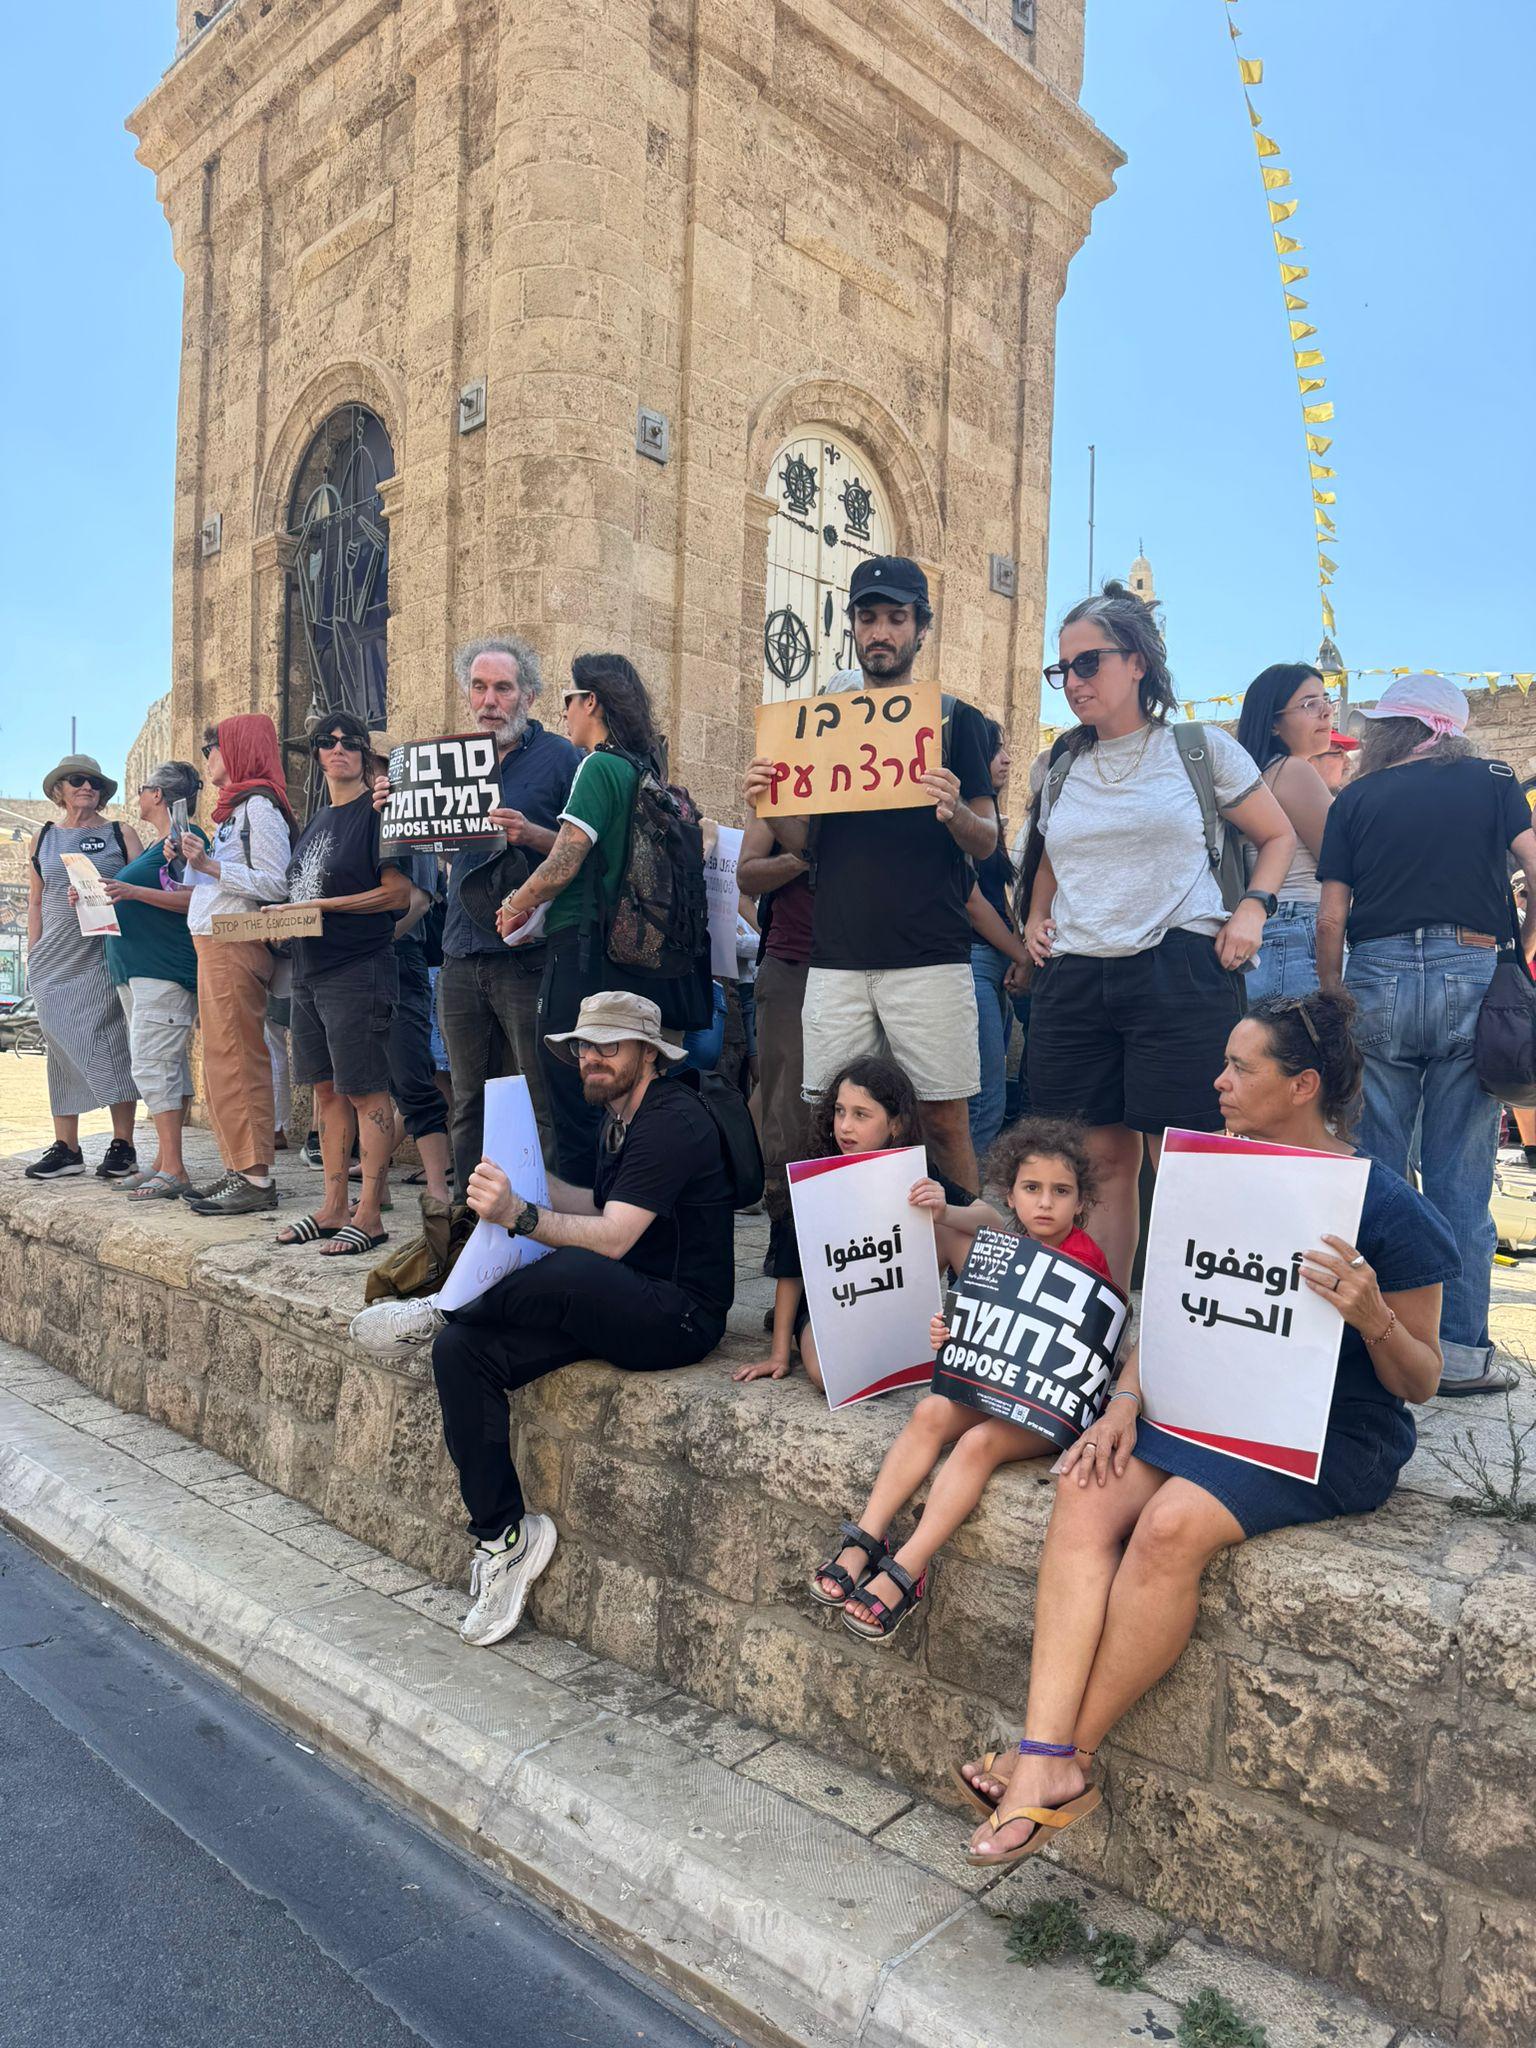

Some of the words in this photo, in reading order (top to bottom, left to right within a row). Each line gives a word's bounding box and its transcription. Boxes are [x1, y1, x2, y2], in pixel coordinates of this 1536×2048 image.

[796, 695, 911, 739] סרבו
[830, 727, 934, 792] לרצח
[383, 778, 500, 822] למלחמה
[771, 762, 815, 805] עם
[382, 821, 429, 839] OPPOSE
[431, 818, 463, 835] THE
[213, 921, 239, 935] STOP
[244, 918, 263, 930] THE
[266, 915, 302, 930] GENOCIDE
[303, 913, 318, 926] NOW
[825, 1224, 903, 1273] أوقفوا
[968, 1254, 1009, 1276] בעיניים
[973, 1242, 1016, 1260] לכיבוש
[1184, 1239, 1304, 1296] أوقفوا
[832, 1266, 904, 1309] الحرب
[1182, 1293, 1294, 1338] الحرب
[943, 1344, 1022, 1388] OPPOSE
[1024, 1369, 1081, 1417] THE
